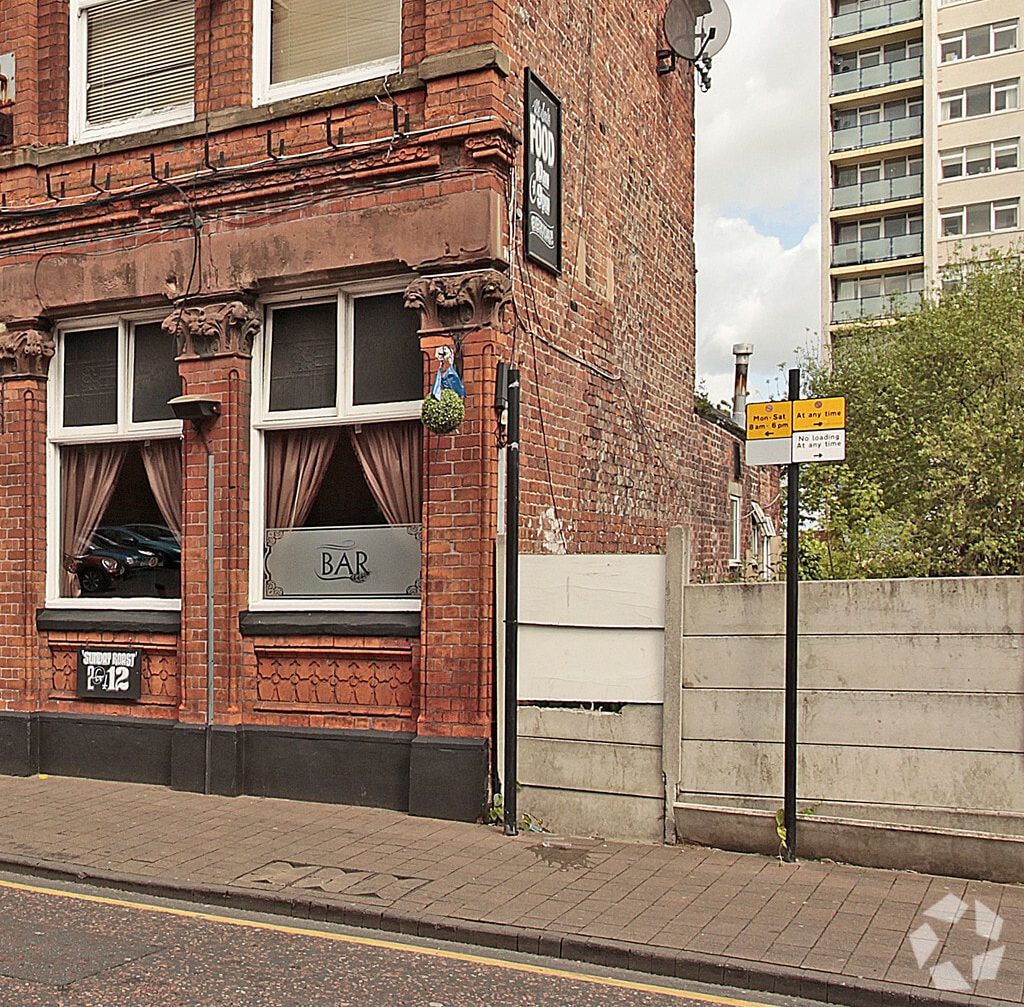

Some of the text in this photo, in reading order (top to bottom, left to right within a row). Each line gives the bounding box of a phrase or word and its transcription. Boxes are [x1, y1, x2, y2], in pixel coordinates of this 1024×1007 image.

[530, 113, 555, 167] FOOD
[808, 411, 822, 420] any
[812, 434, 840, 442] loading
[808, 442, 822, 450] any
[321, 551, 371, 576] BAR
